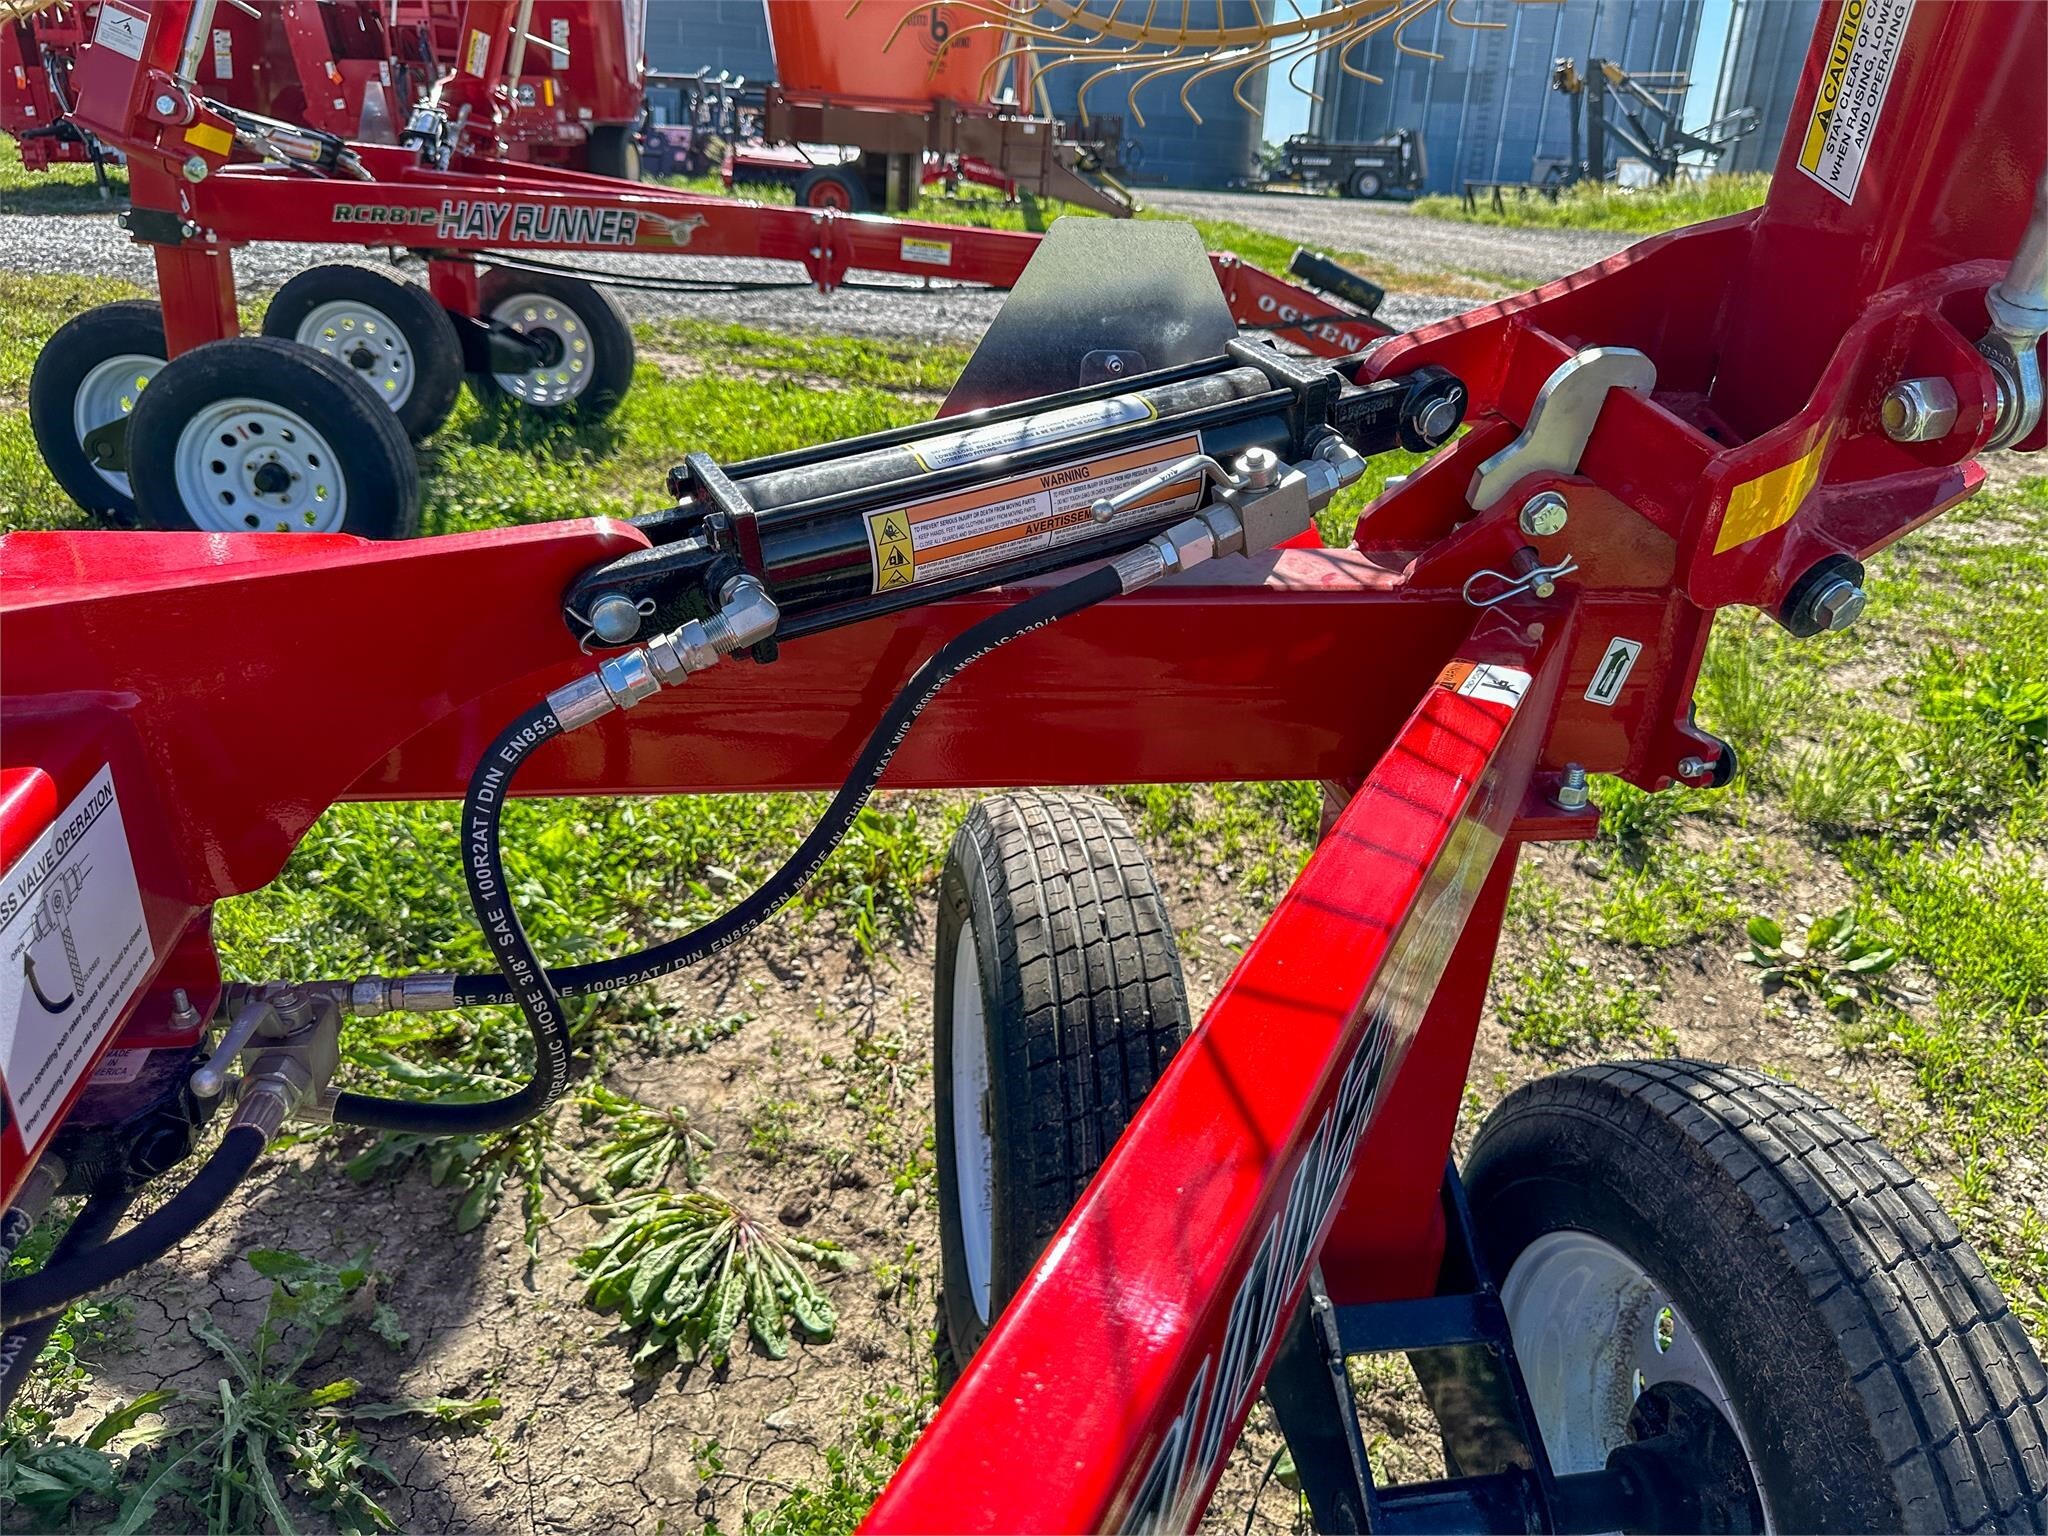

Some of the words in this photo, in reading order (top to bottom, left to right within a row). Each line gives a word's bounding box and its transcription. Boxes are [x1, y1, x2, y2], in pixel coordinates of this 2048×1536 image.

[1824, 0, 1862, 102] CAUTIO
[1827, 112, 1843, 154] STAY
[1840, 52, 1862, 109] CLEAR
[1858, 24, 1870, 47] OF
[1867, 0, 1879, 19] CA
[1830, 134, 1851, 181] WHEN
[1847, 56, 1877, 130] RAISING,
[1871, 0, 1893, 50] LOWE
[1852, 112, 1871, 149] AND
[1867, 5, 1905, 107] OPERATING
[332, 204, 437, 225] RCR812
[438, 200, 512, 240] HAY
[511, 205, 640, 246] RUNNER
[1039, 466, 1090, 488] WARNING
[1023, 509, 1093, 535] AVERTISSEM
[499, 714, 558, 764] EN853
[478, 765, 505, 805] DIN
[17, 848, 55, 898] VALVE
[55, 781, 113, 856] OPERATION
[453, 994, 477, 1006] SE
[487, 992, 514, 1004] 3/8
[583, 965, 660, 992] 100R2AT
[674, 950, 704, 969] DIN
[710, 918, 758, 953] EN853
[763, 891, 790, 918] 2SN
[793, 851, 829, 890] MADE
[829, 831, 844, 850] IN
[844, 783, 875, 827] CHINA
[873, 748, 896, 778] MAX
[892, 720, 911, 744] W/P
[932, 672, 954, 693] PSI
[472, 816, 495, 901] 100R2AT
[11, 940, 25, 961] OPEN
[488, 907, 514, 946] SAE
[507, 956, 534, 985] 3/8"
[18, 1085, 35, 1106] When
[35, 1047, 59, 1090] operating
[57, 1027, 70, 1050] both
[69, 1012, 82, 1031] rakes
[82, 988, 98, 1015] Bypass
[97, 972, 110, 992] Valve
[109, 951, 124, 976] should
[123, 944, 130, 955] be
[129, 925, 142, 946] closed
[527, 990, 558, 1036] HOSE
[24, 1110, 40, 1133] When
[40, 1072, 64, 1114] operating
[63, 1056, 73, 1076] with
[73, 1047, 83, 1062] one
[82, 1031, 93, 1050] rake
[92, 1006, 108, 1035] Bypass
[108, 989, 120, 1010] Valve
[119, 967, 134, 994] should
[133, 959, 140, 972] be
[138, 946, 148, 964] open
[0, 1334, 27, 1380] HYD
